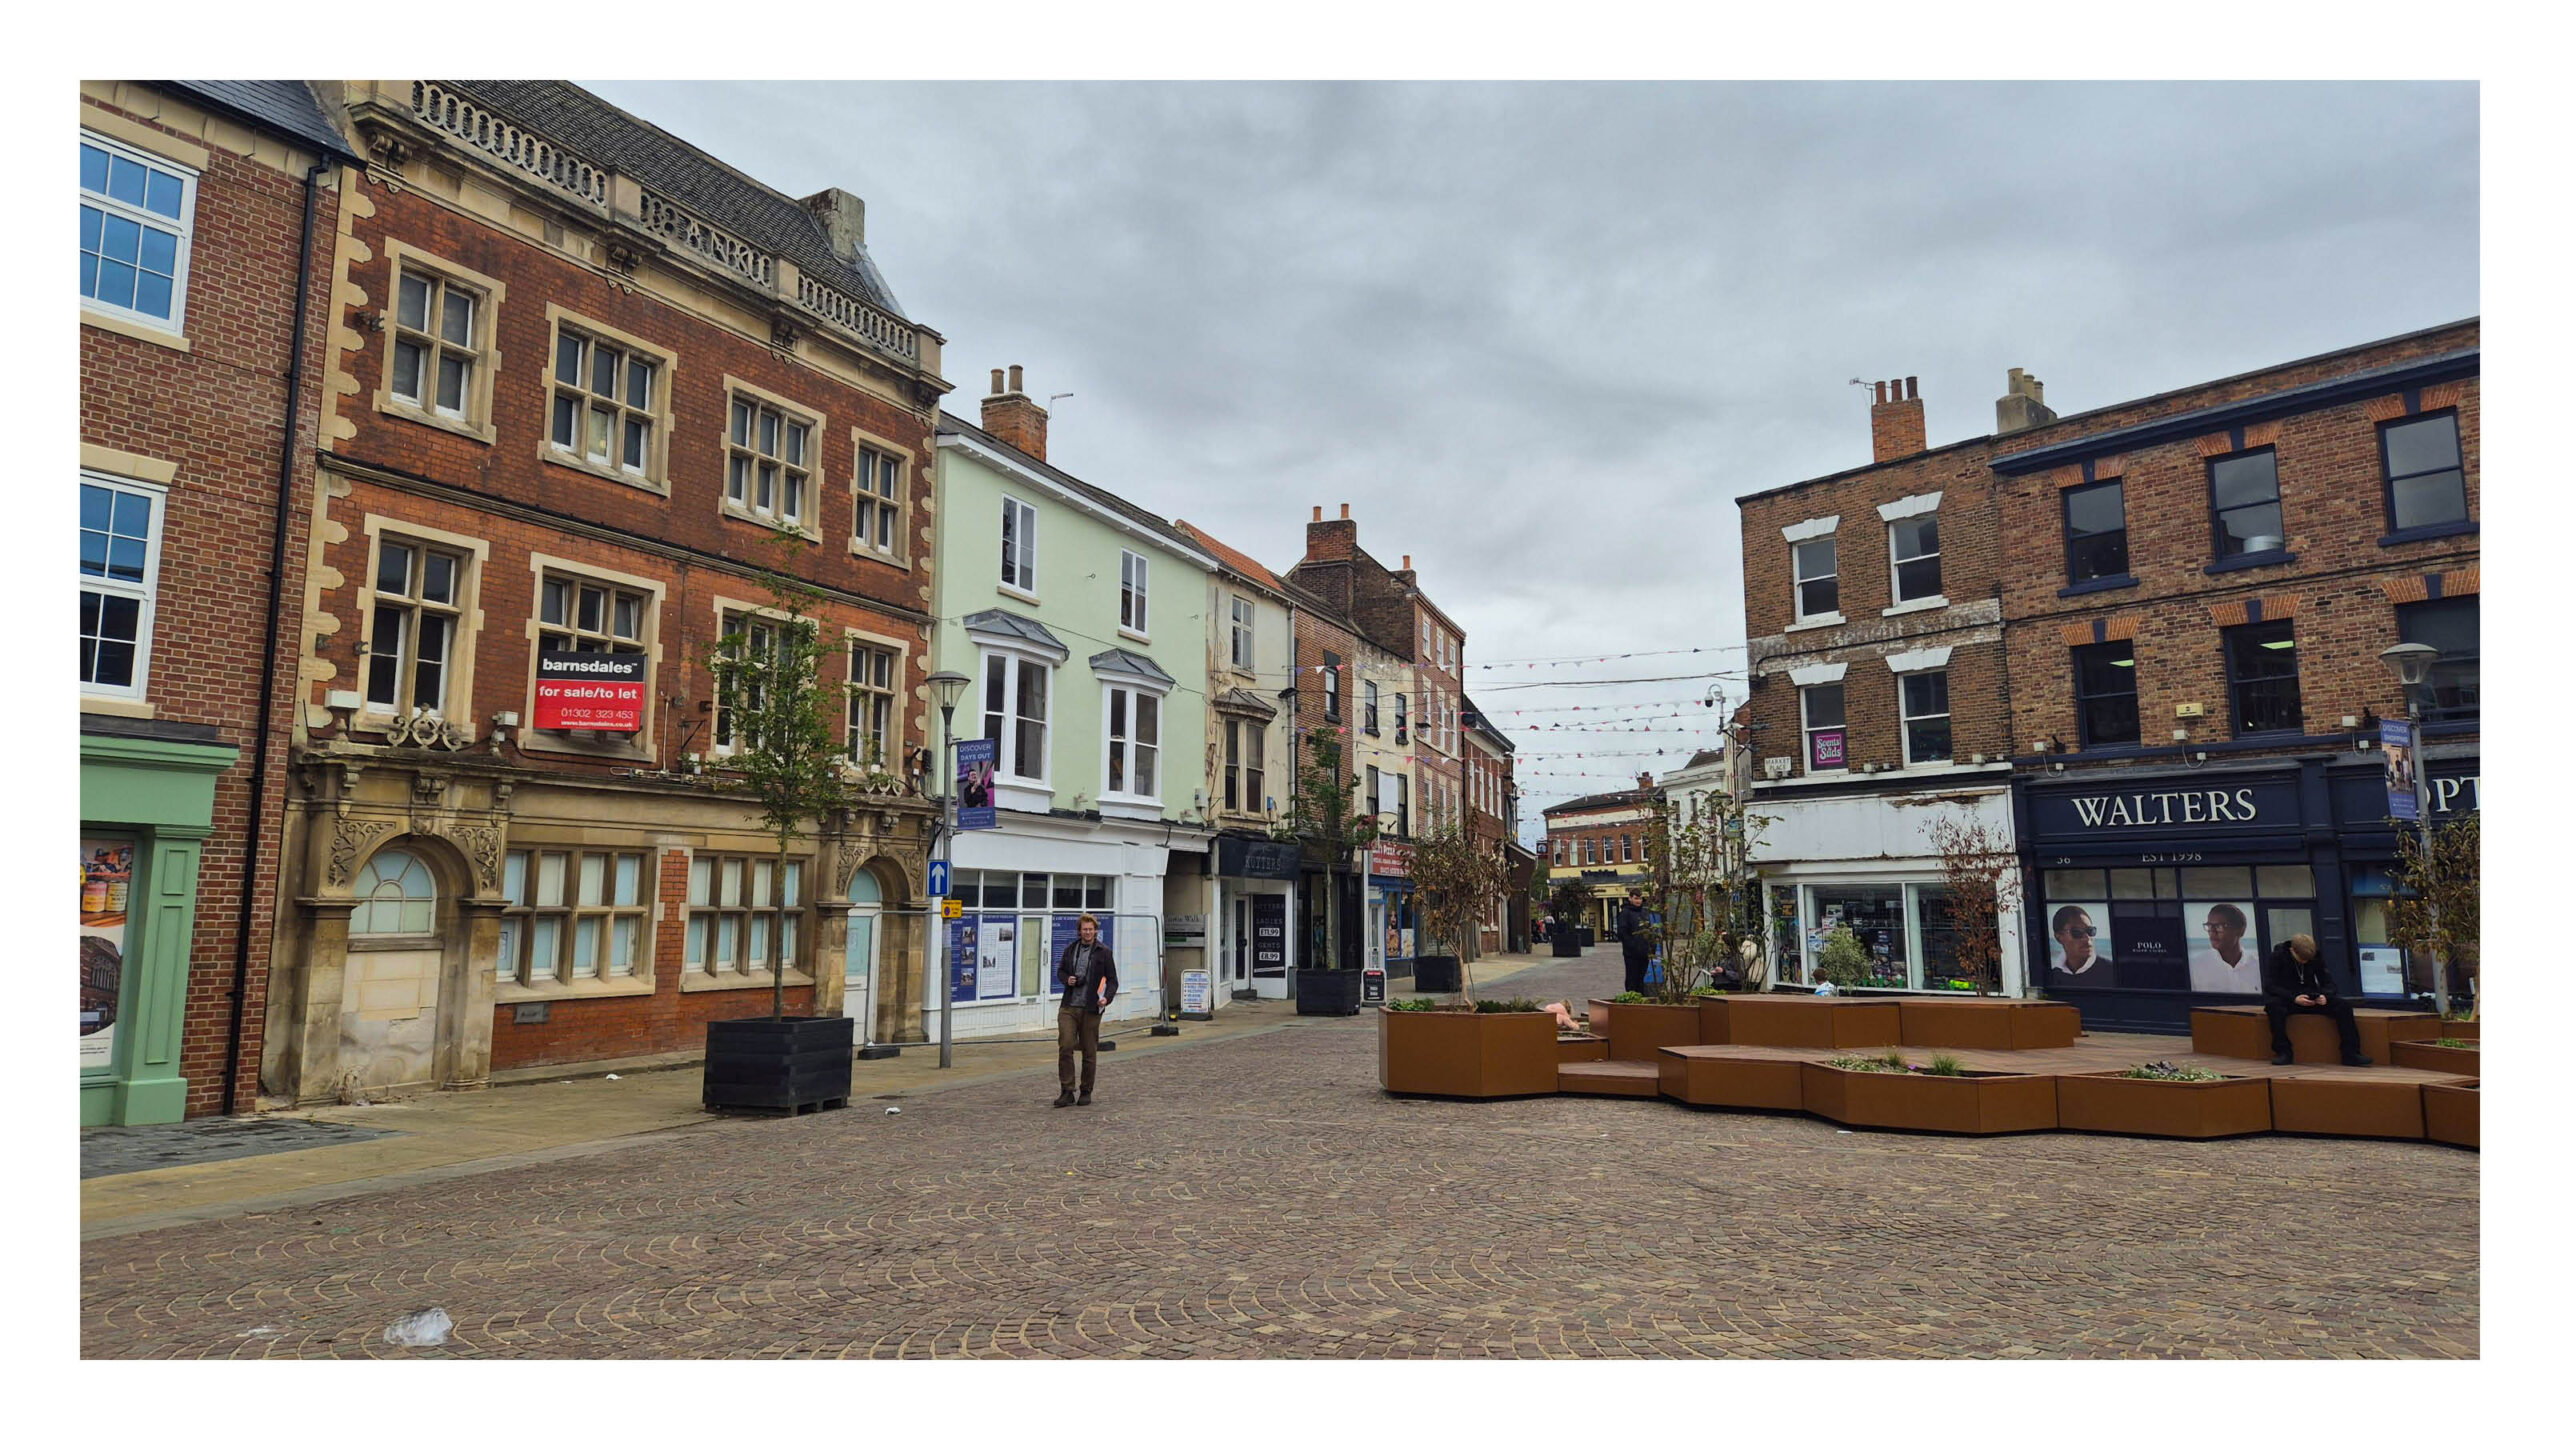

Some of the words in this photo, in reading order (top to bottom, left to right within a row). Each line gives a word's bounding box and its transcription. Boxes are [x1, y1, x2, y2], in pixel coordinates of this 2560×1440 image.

[539, 686, 560, 697] for
[564, 688, 614, 699] sale/to
[618, 687, 637, 699] let
[561, 708, 591, 718] 01302
[595, 709, 614, 719] 323
[616, 711, 634, 720] 453
[2383, 724, 2407, 734] DISCOVER
[960, 744, 991, 752] DISCOVER
[1766, 757, 1790, 765] MARKET
[2071, 788, 2257, 827] WALTERS
[2142, 853, 2164, 862] EST
[2137, 941, 2161, 949] POLO
